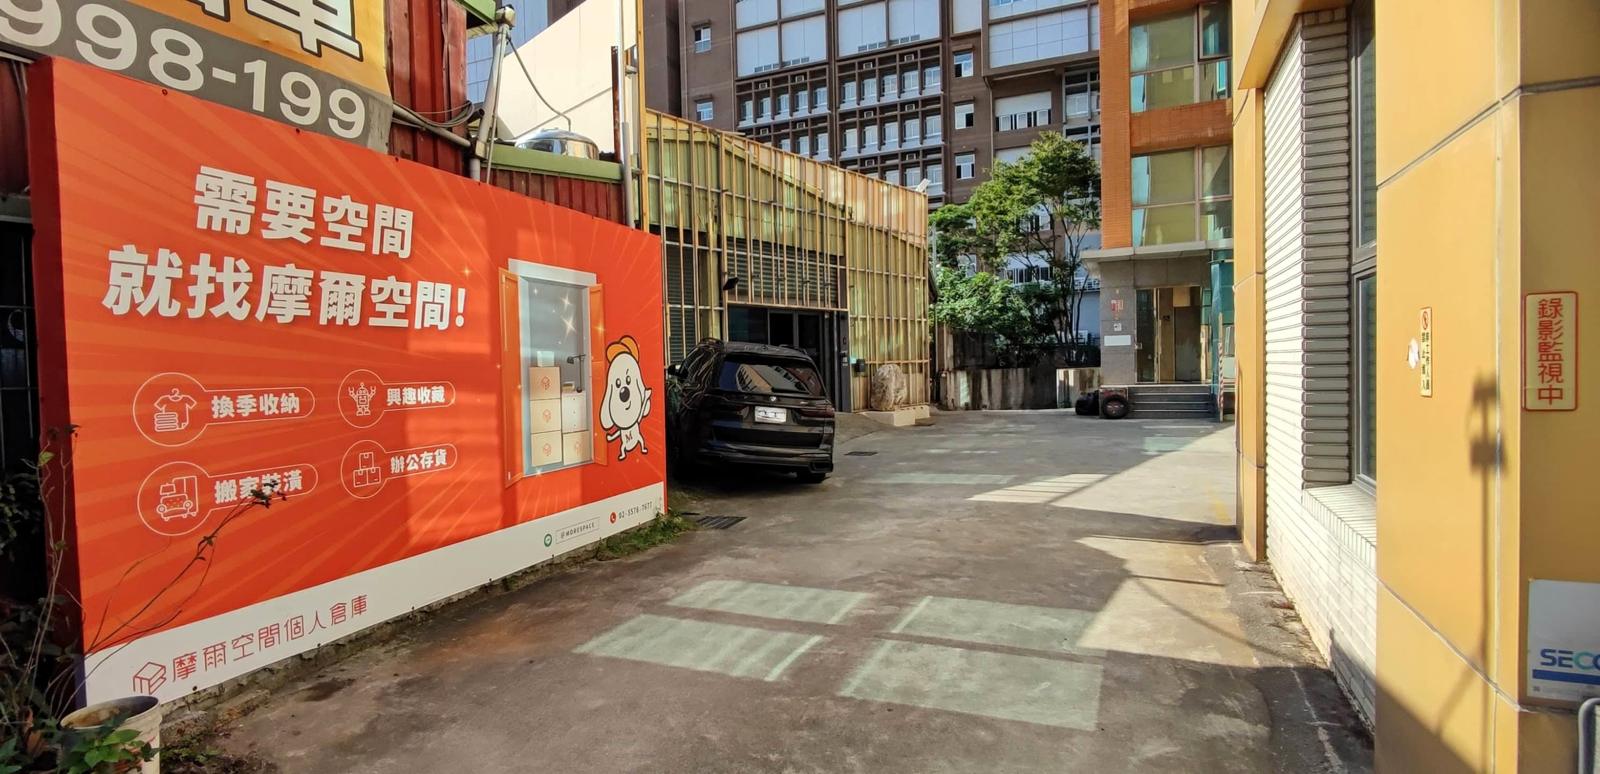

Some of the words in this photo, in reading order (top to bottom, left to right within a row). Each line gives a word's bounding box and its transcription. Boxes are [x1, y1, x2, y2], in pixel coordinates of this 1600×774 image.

[194, 165, 414, 259] 需要空間
[102, 245, 466, 331] 就找摩爾空間!
[1537, 297, 1564, 405] 錄影監視中
[211, 393, 300, 419] 換季收納
[387, 386, 446, 406] 興趣收藏
[214, 469, 303, 504] 搬家裝潢
[390, 448, 447, 474] 辦公存貨
[172, 594, 368, 683] 摩爾空間個人倉庫
